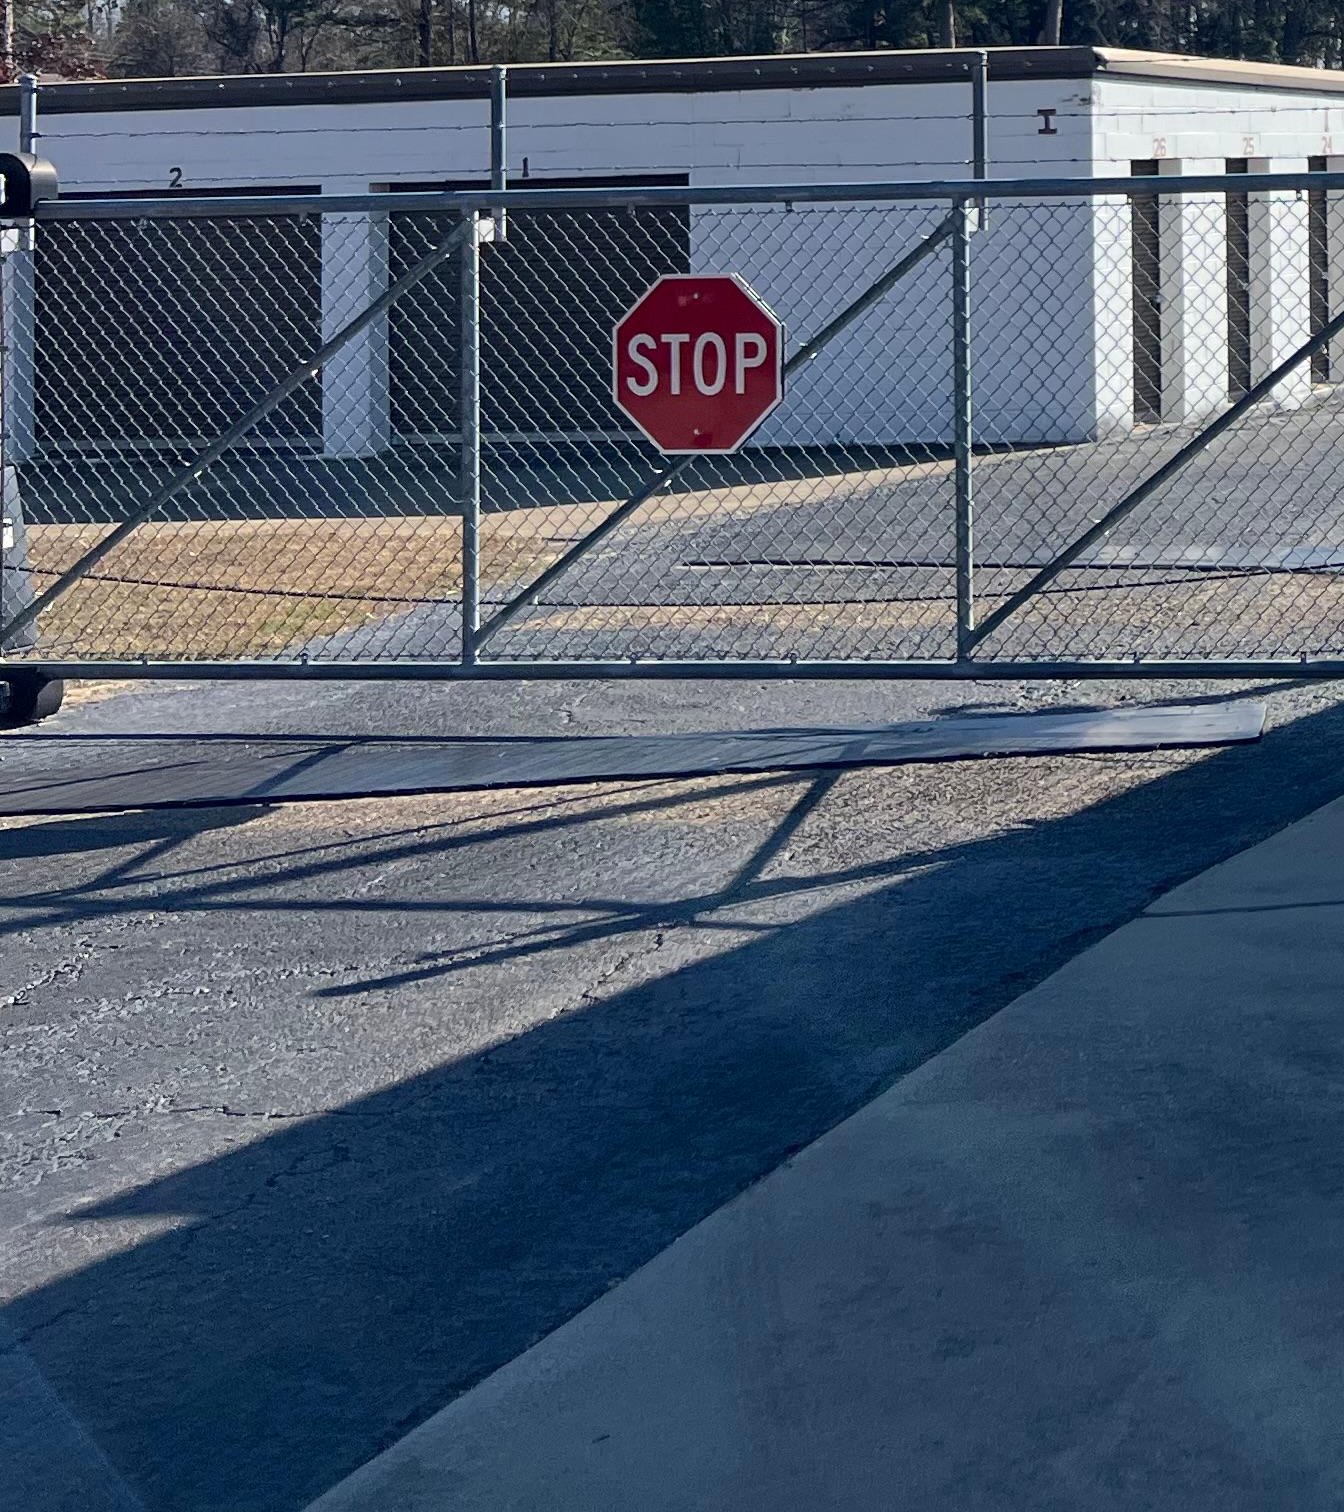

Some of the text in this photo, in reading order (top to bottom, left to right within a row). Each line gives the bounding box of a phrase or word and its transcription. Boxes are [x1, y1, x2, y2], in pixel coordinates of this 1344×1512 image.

[1243, 137, 1255, 155] 25
[169, 167, 182, 188] 2
[626, 331, 768, 397] STOP
